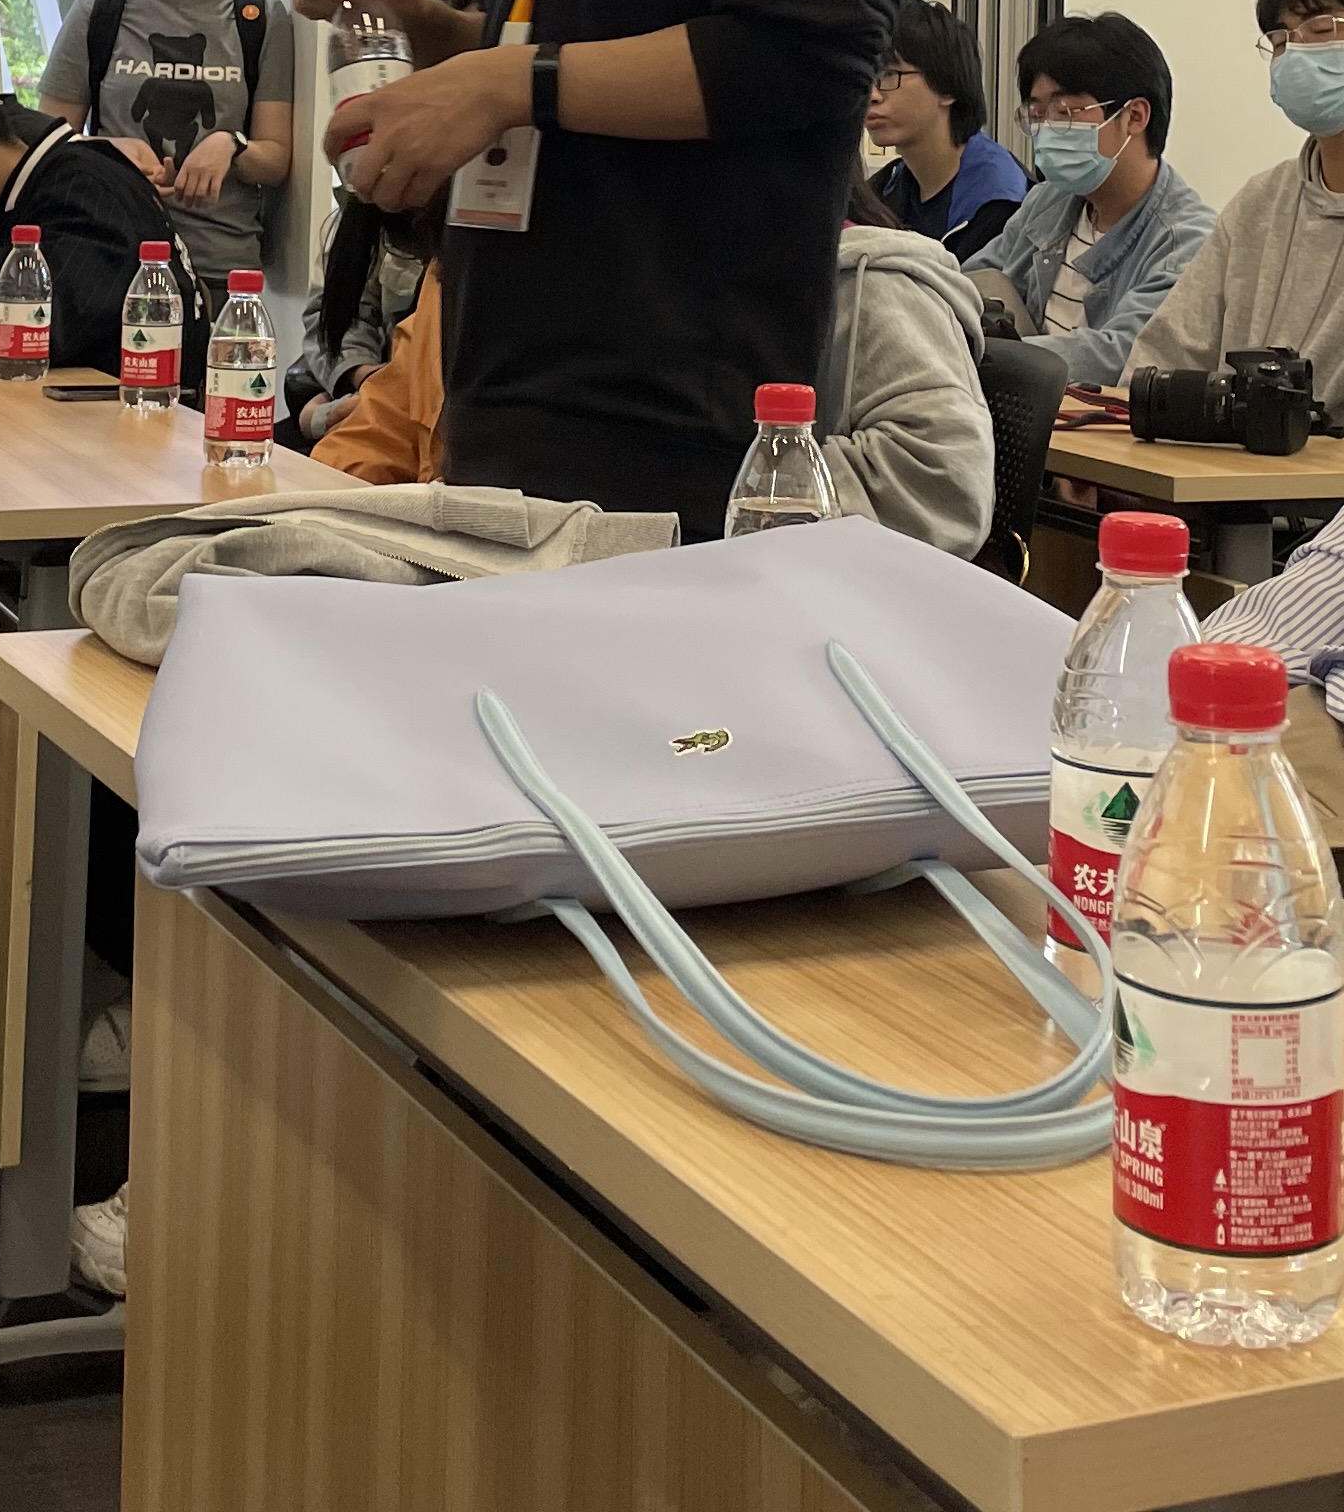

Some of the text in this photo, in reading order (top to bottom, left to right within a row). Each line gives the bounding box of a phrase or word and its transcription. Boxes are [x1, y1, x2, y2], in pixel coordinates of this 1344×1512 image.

[115, 59, 242, 83] HARDIOR
[1115, 1106, 1164, 1163] 山泉
[1120, 1150, 1164, 1188] SPRING
